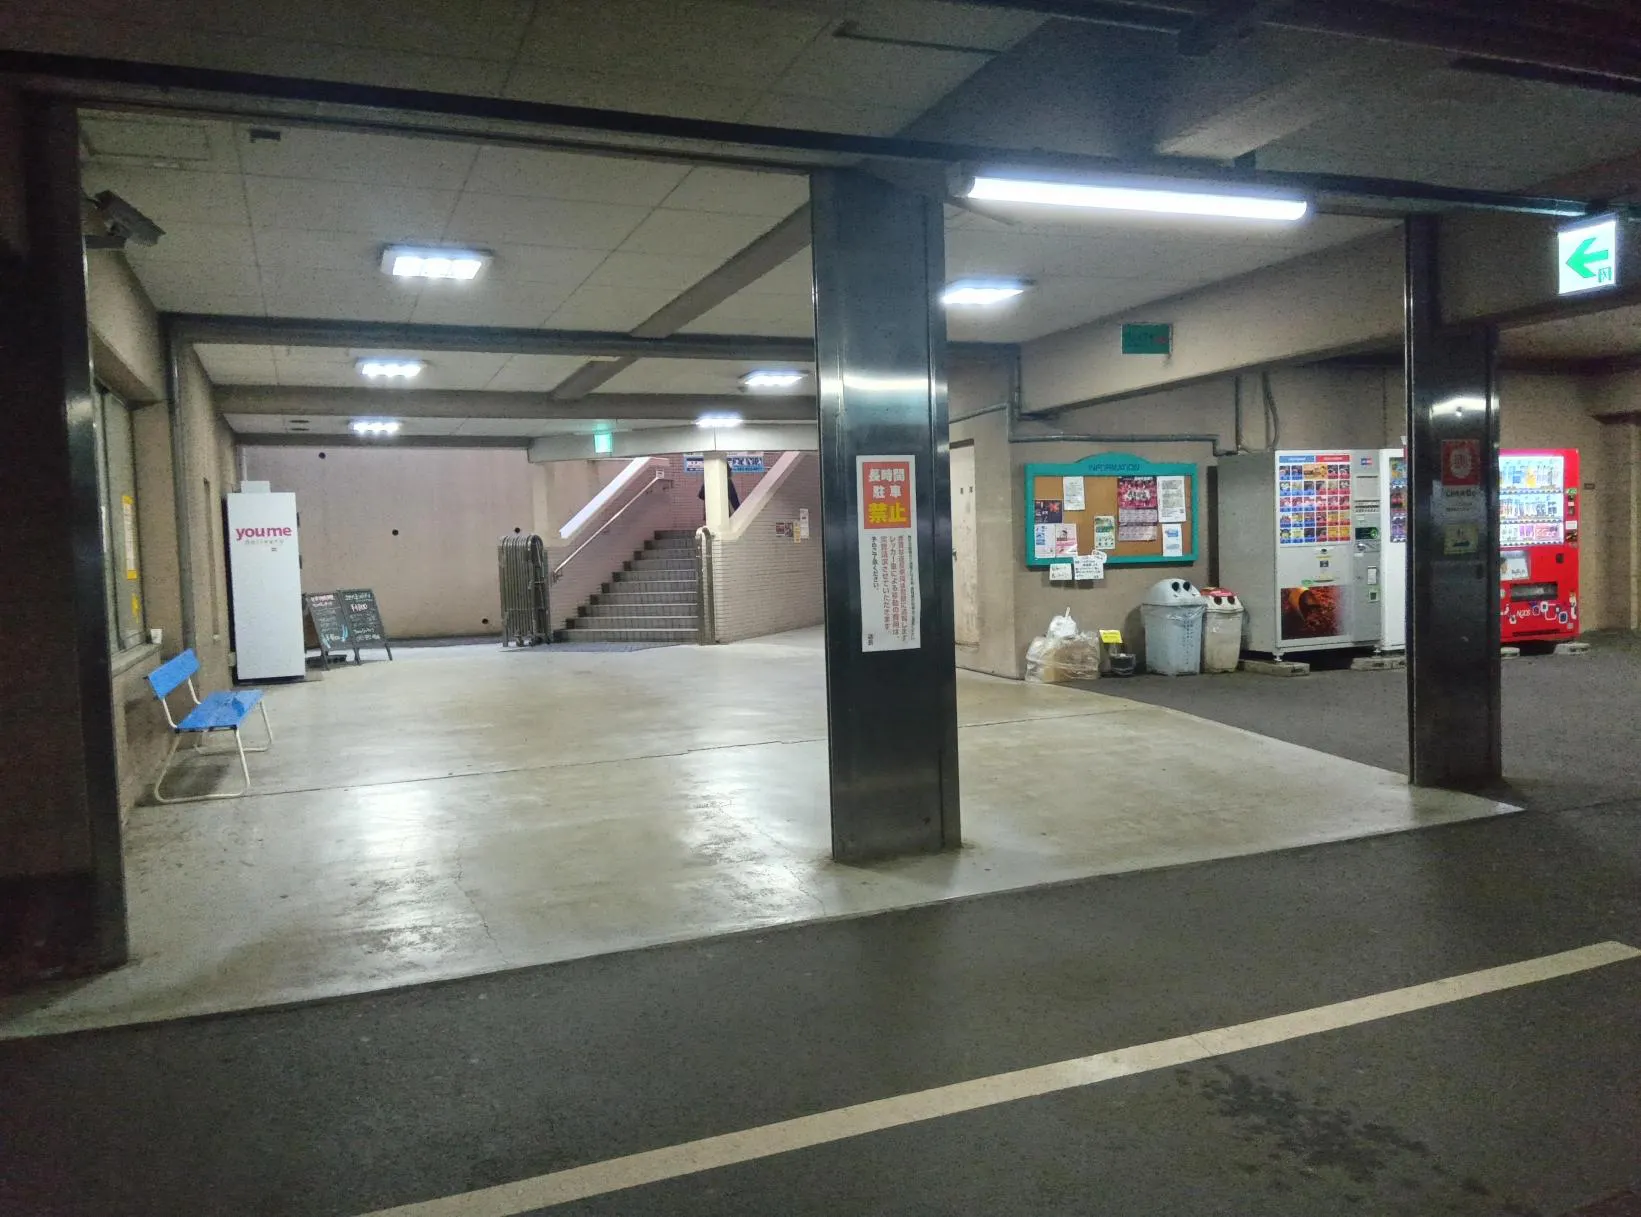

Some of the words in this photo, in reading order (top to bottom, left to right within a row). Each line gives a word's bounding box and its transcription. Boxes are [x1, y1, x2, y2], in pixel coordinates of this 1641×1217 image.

[1088, 463, 1140, 472] INFORMATION
[869, 468, 905, 482] 長時間
[868, 502, 908, 524] 禁止
[235, 527, 292, 541] youme
